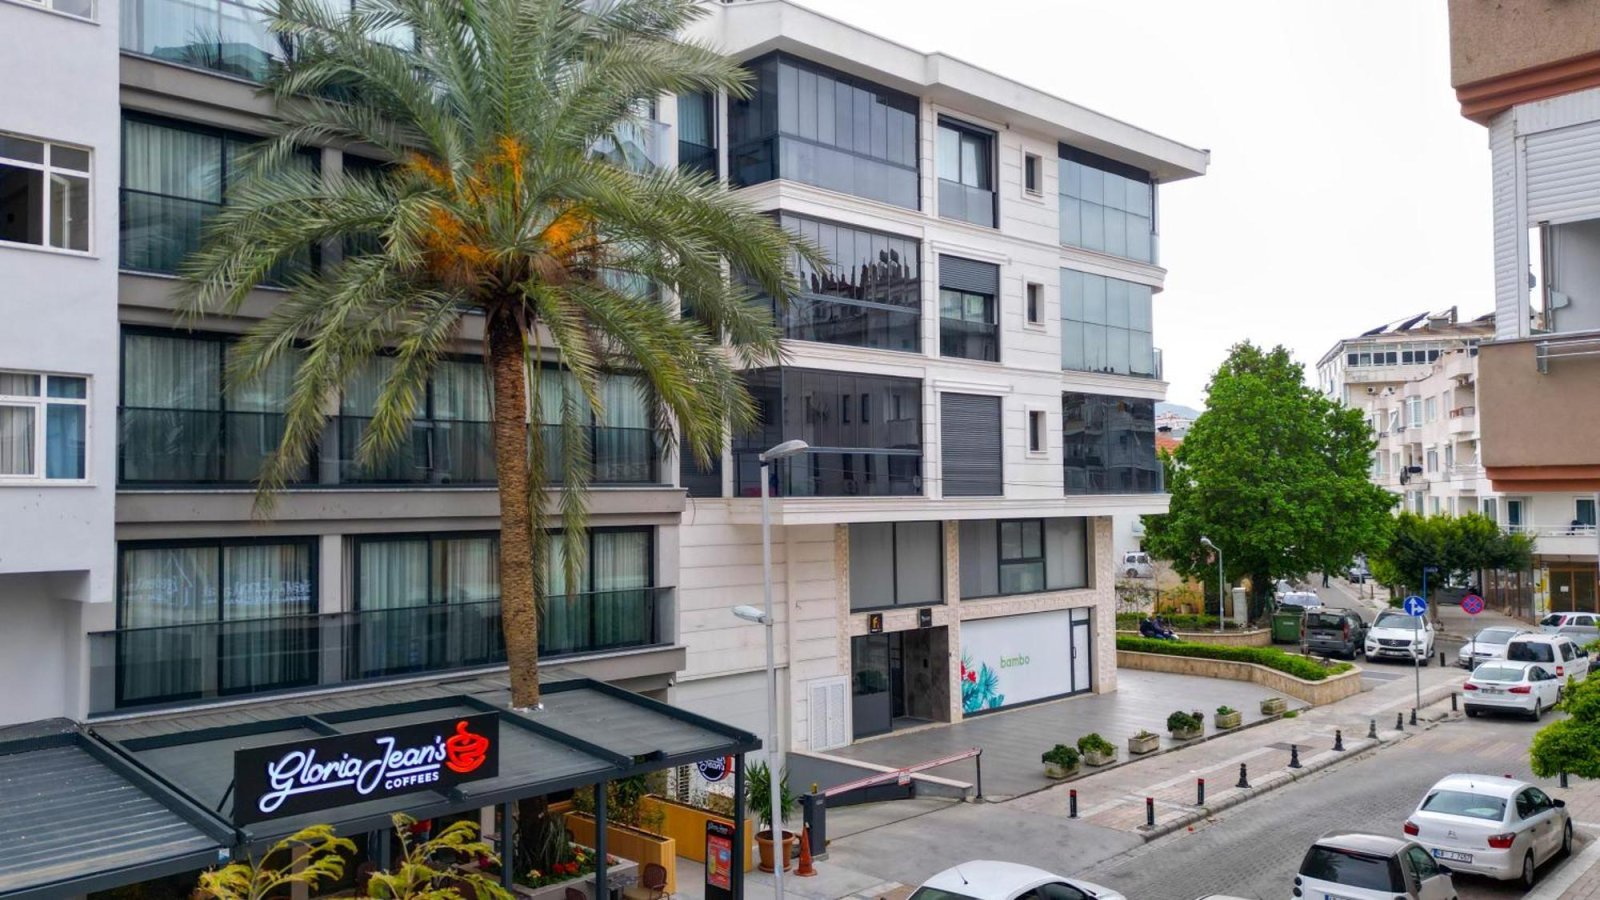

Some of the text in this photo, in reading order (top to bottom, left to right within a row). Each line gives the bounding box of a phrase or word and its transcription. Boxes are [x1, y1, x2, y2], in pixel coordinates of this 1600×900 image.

[1000, 651, 1031, 669] bambo
[259, 735, 447, 813] Gloria Jean's
[384, 771, 440, 790] COFFEES
